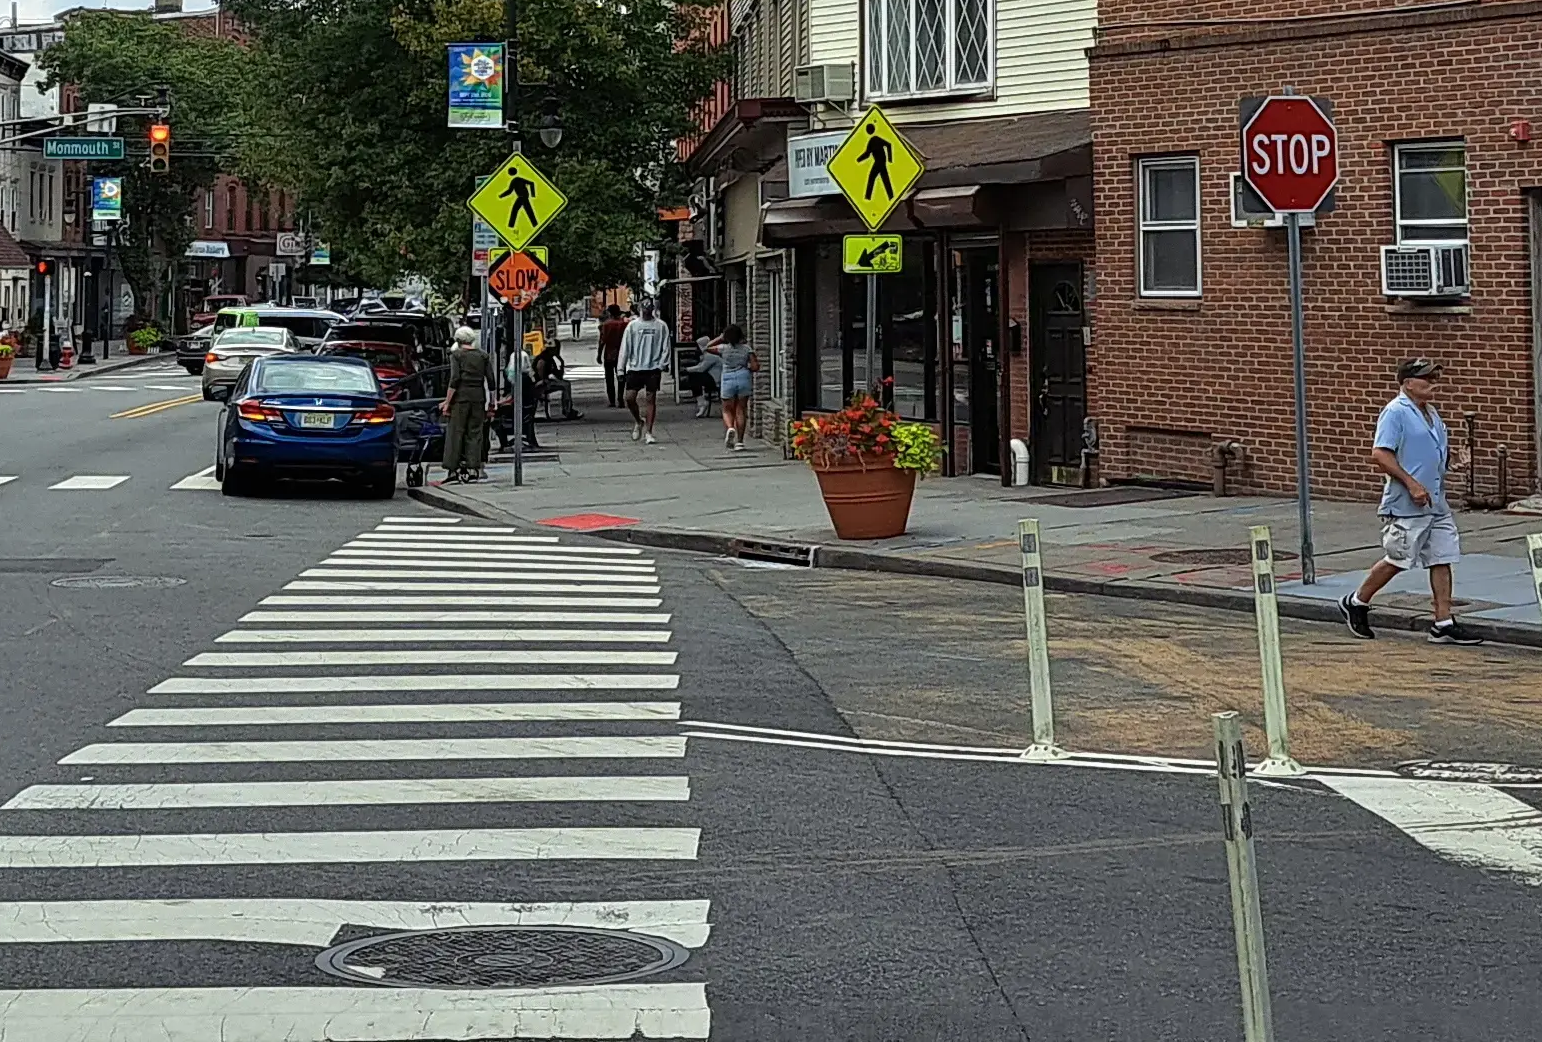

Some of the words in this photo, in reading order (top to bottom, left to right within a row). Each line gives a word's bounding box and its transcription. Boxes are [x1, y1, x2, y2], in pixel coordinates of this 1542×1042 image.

[47, 141, 109, 155] Monmouth
[1251, 133, 1331, 175] STOP
[495, 268, 540, 291] SLOW
